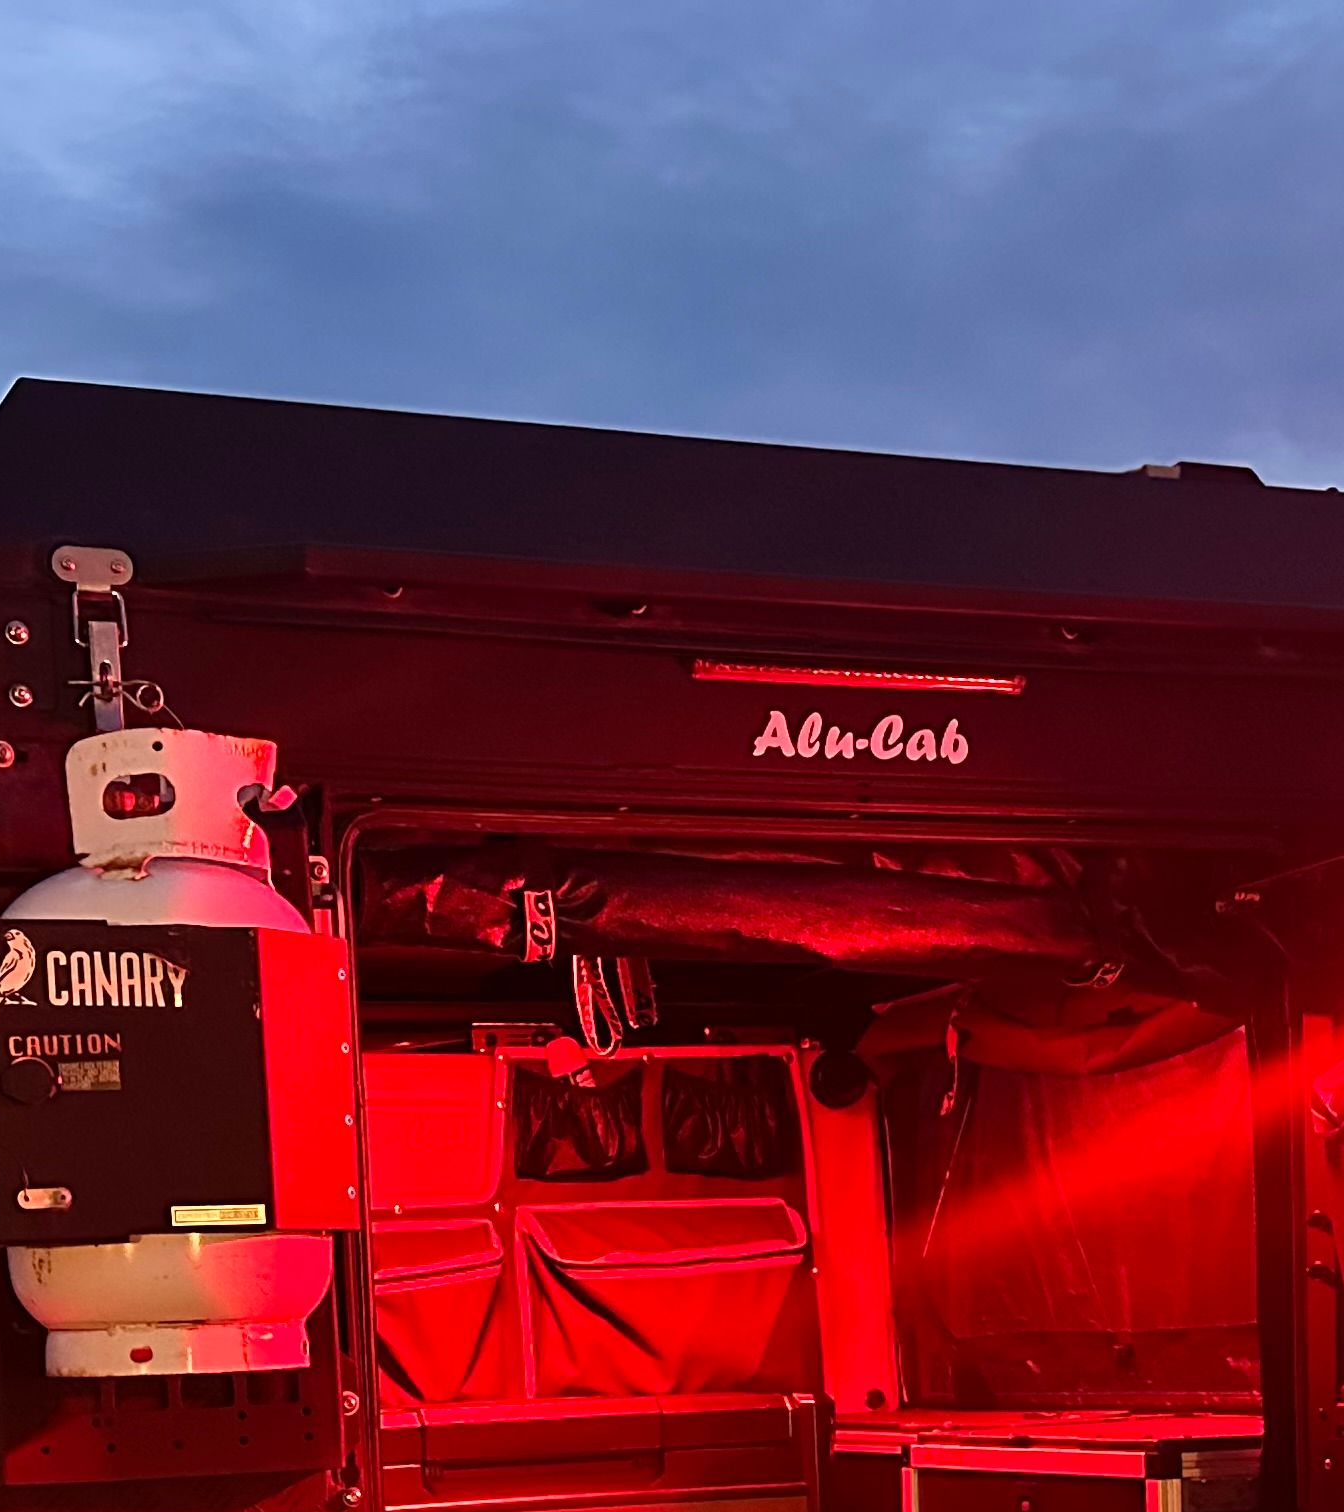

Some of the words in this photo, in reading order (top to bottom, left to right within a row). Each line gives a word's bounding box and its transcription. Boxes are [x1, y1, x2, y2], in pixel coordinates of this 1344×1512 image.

[752, 710, 969, 764] Alu-Cab
[46, 950, 188, 1008] CANARY
[8, 1033, 123, 1057] CAUTION
